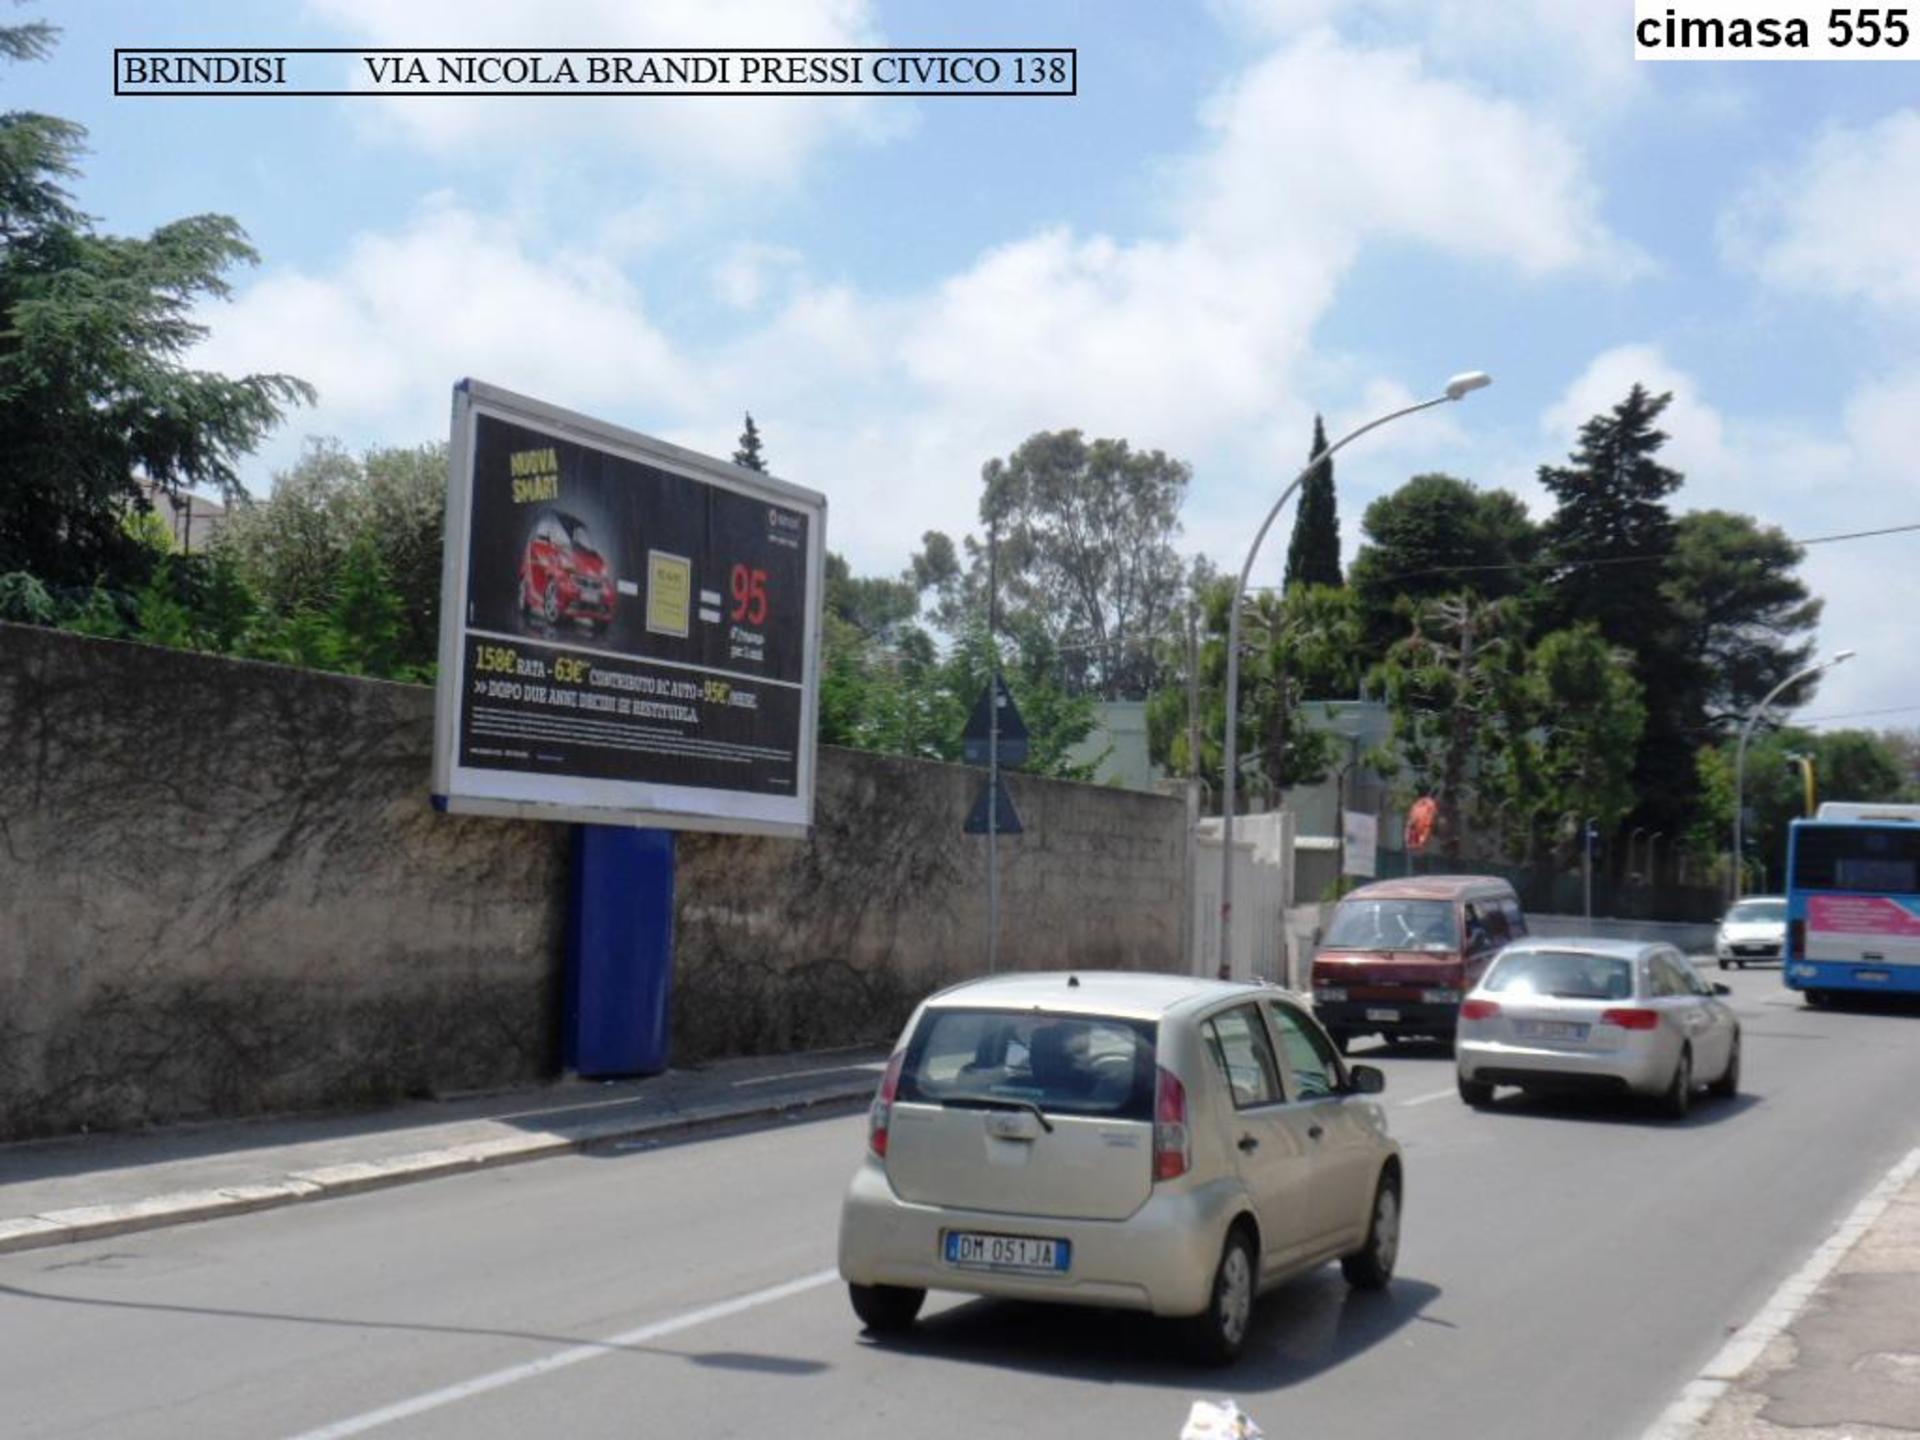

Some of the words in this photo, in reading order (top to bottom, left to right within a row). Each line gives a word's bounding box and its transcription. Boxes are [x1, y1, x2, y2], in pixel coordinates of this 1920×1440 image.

[511, 447, 558, 477] NUOVA
[512, 475, 559, 503] SMART
[731, 563, 769, 625] 95
[488, 680, 522, 700] DOPO
[523, 684, 547, 703] DUE
[516, 658, 546, 678] RATA
[671, 680, 697, 700] AUTO
[961, 1237, 984, 1258] DM
[992, 1240, 1052, 1264] 051JA
